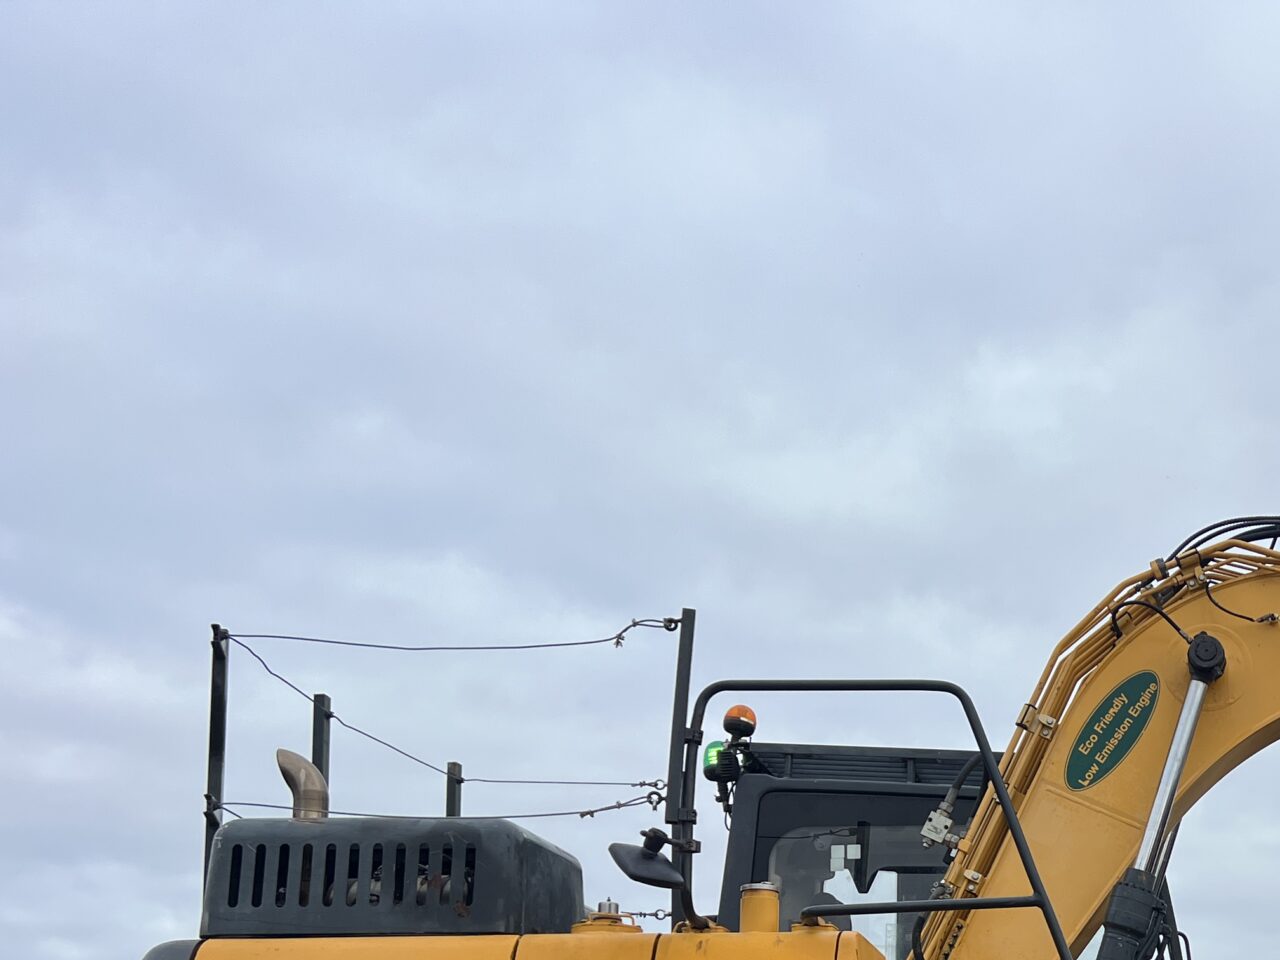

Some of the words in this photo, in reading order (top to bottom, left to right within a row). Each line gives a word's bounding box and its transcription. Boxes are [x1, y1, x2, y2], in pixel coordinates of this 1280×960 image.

[1078, 734, 1098, 755] Eco
[1094, 693, 1128, 734] Friendly
[1078, 763, 1099, 786] Low
[1095, 717, 1133, 764] Emission
[1128, 682, 1158, 718] Engine
